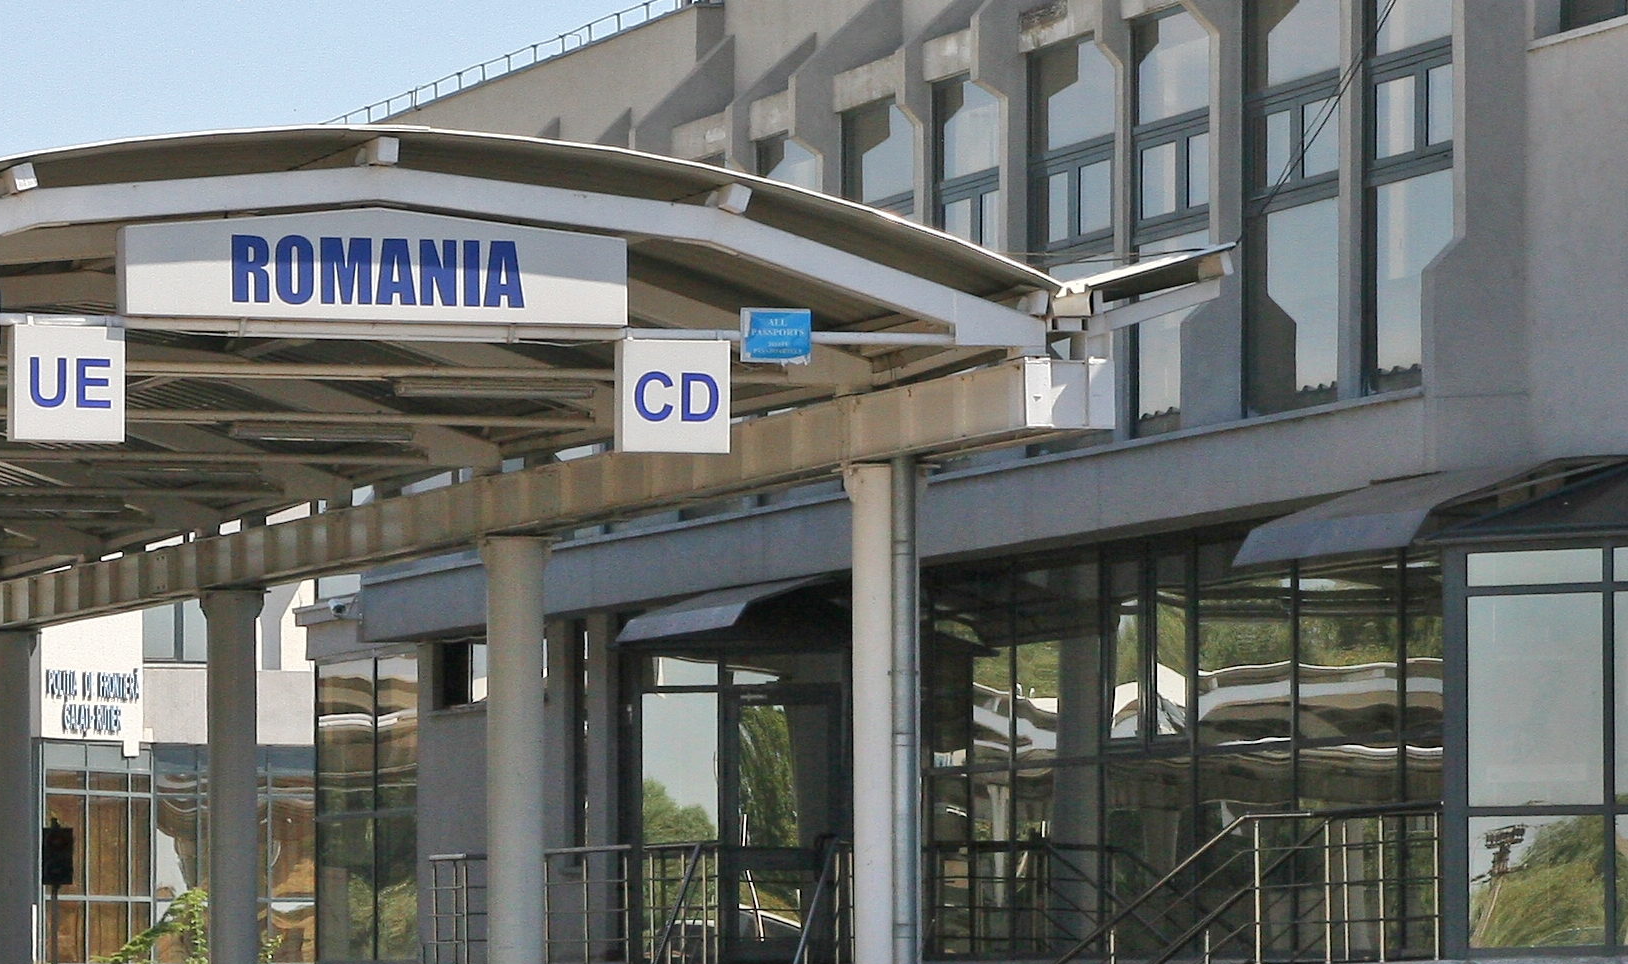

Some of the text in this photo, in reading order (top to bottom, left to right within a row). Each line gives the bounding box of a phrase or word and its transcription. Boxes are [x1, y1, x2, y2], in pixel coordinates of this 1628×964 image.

[230, 234, 525, 309] ROMANIA
[29, 357, 112, 409] UE
[633, 371, 720, 423] CD
